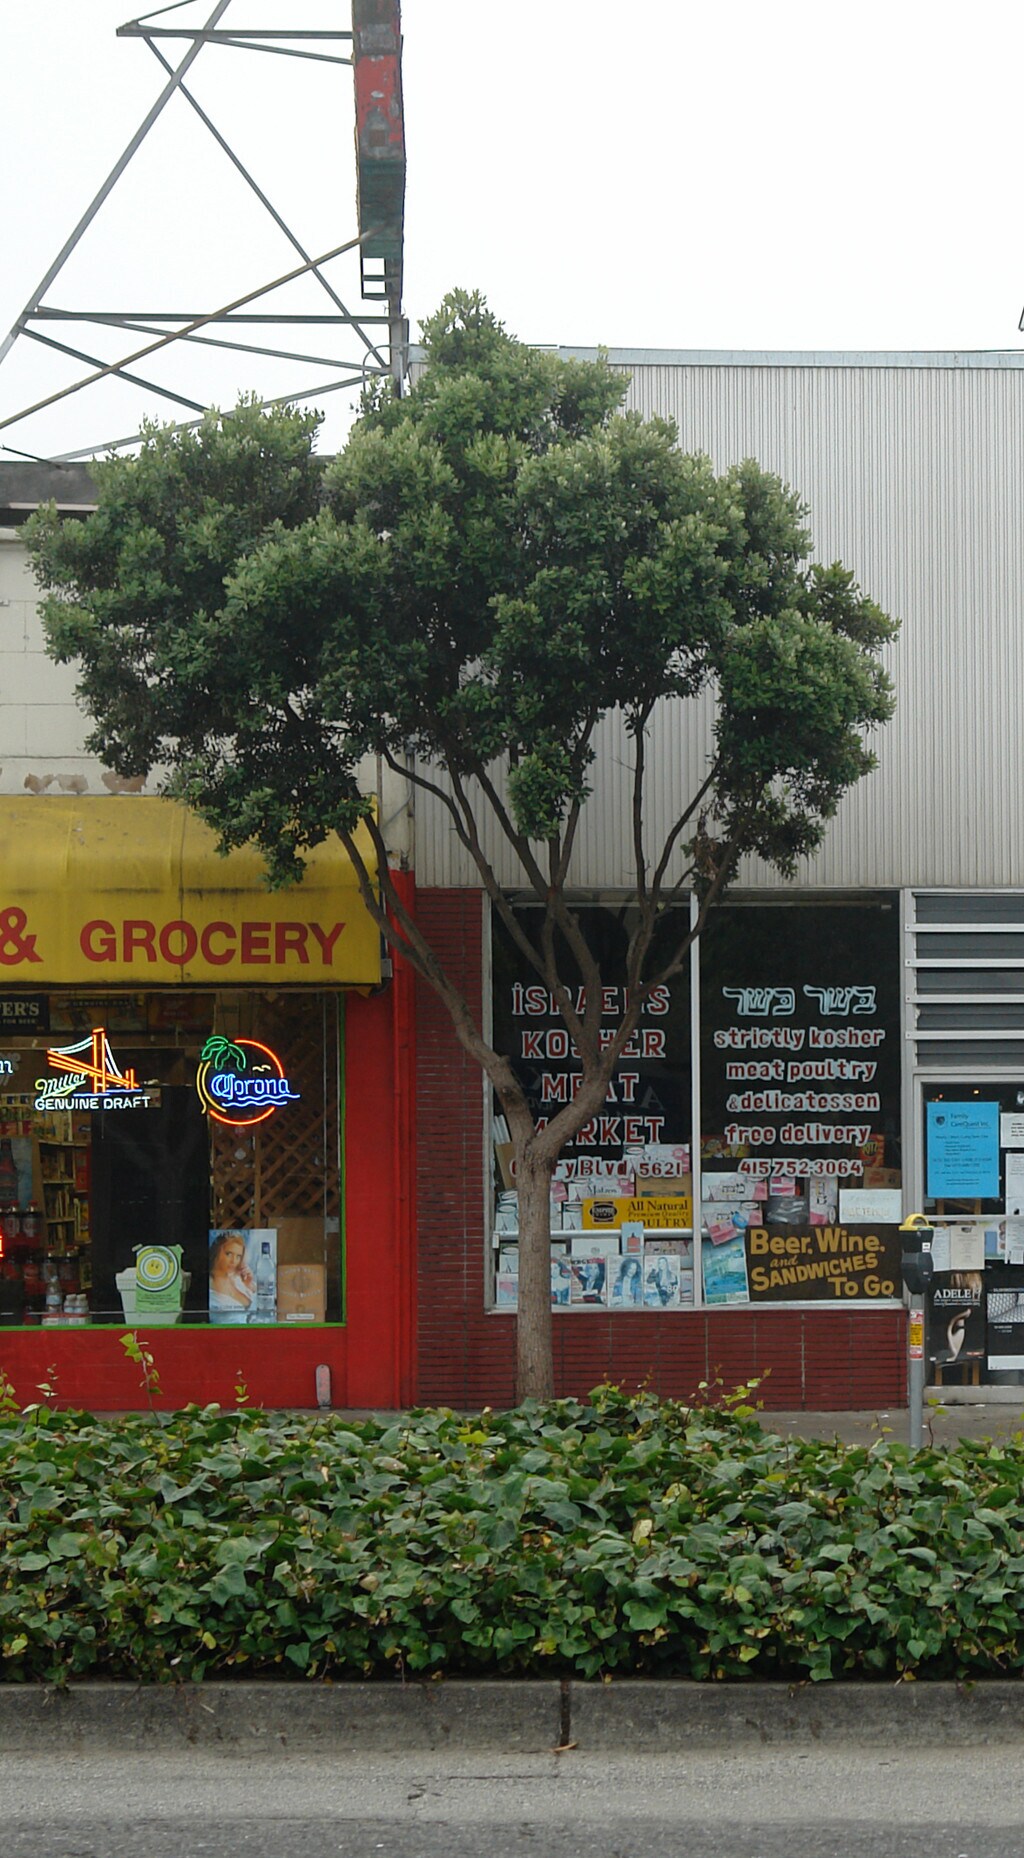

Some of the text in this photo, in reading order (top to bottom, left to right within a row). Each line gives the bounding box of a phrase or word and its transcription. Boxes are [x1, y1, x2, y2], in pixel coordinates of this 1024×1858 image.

[0, 906, 346, 966] & GROCERY
[0, 1001, 40, 1017] ER'S
[714, 1027, 886, 1051] strictly kosher
[726, 1058, 877, 1082] meat poultry
[35, 1071, 89, 1099] Miller
[211, 1073, 290, 1100] Corona
[34, 1096, 151, 1111] GENUINE DRAFT
[741, 1090, 881, 1112] delicatessen
[724, 1122, 872, 1147] free delivery
[578, 1155, 630, 1180] Blvd
[638, 1160, 683, 1178] 5621
[738, 1158, 771, 1177] 415
[628, 1199, 688, 1211] All Natural
[751, 1253, 878, 1292] SANDWICHES
[770, 1255, 798, 1268] and
[934, 1288, 972, 1299] ADELE
